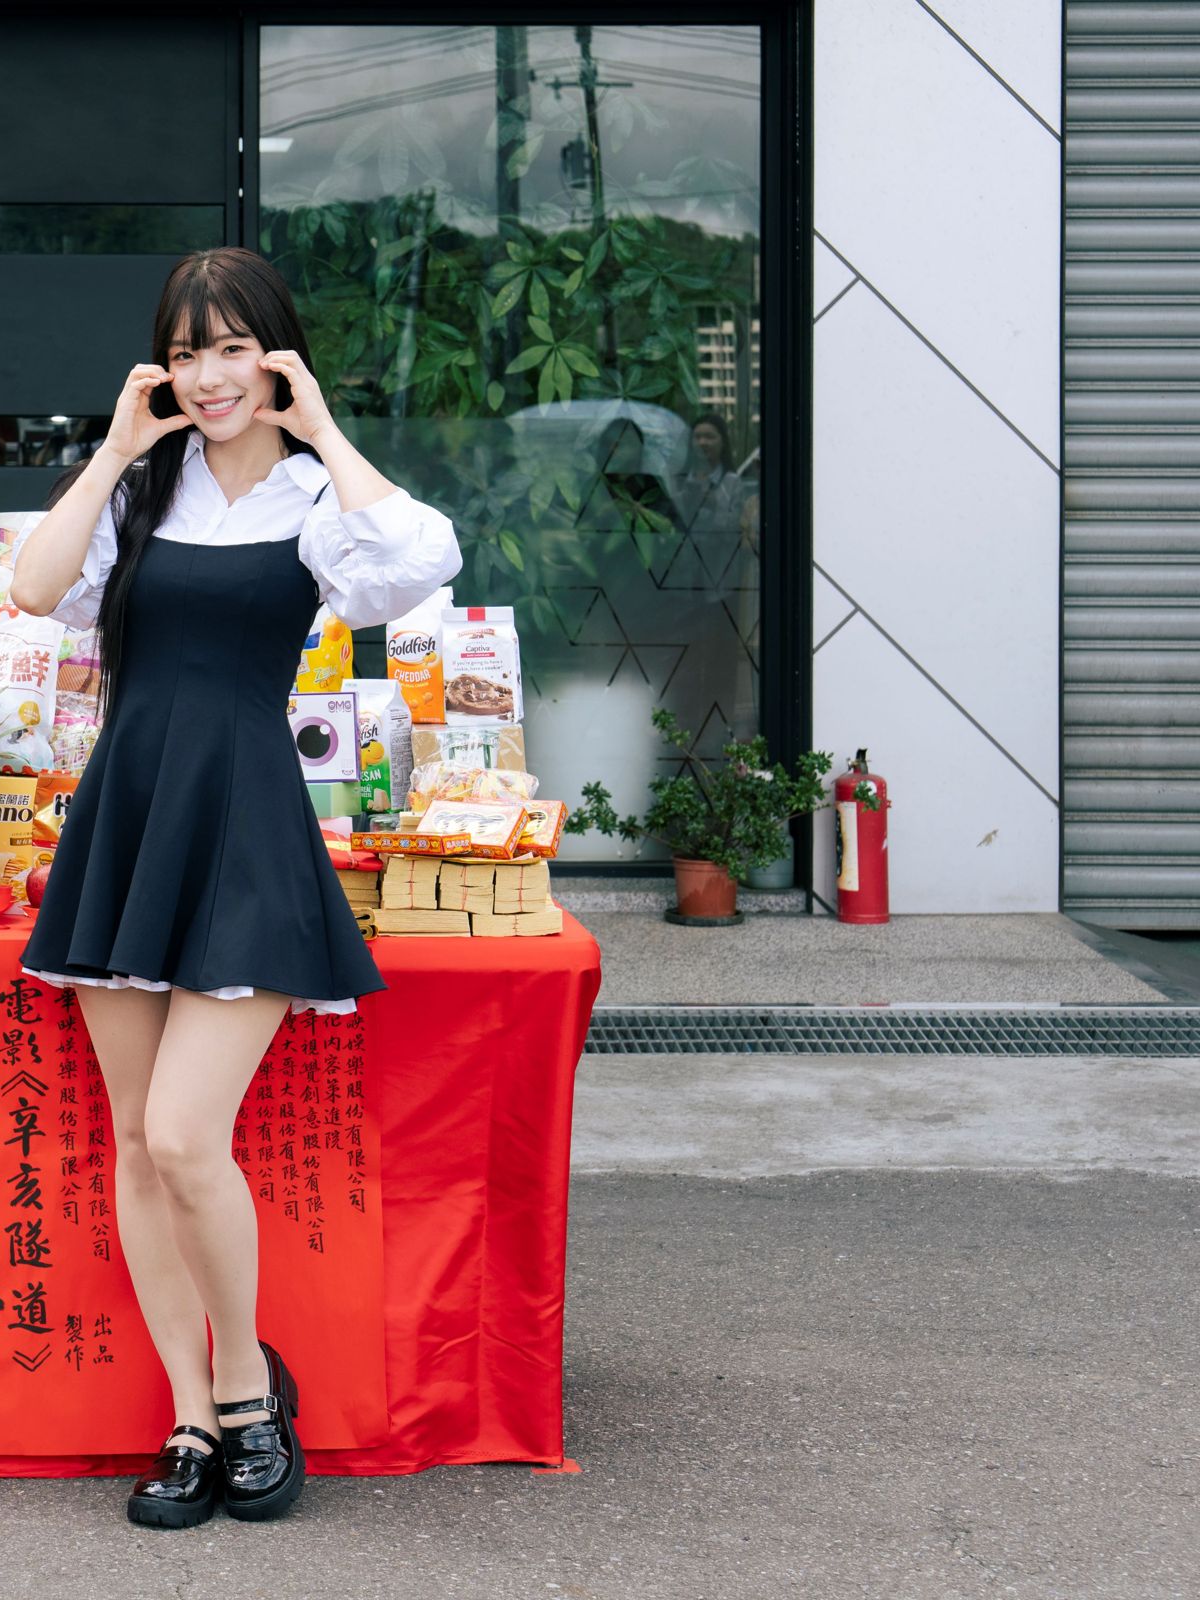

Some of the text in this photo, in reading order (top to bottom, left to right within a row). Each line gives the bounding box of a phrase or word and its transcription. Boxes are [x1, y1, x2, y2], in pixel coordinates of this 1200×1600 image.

[388, 636, 436, 657] Goldfish
[466, 645, 491, 653] Captiva
[394, 668, 432, 683] CHEDDAR
[360, 724, 379, 741] fish
